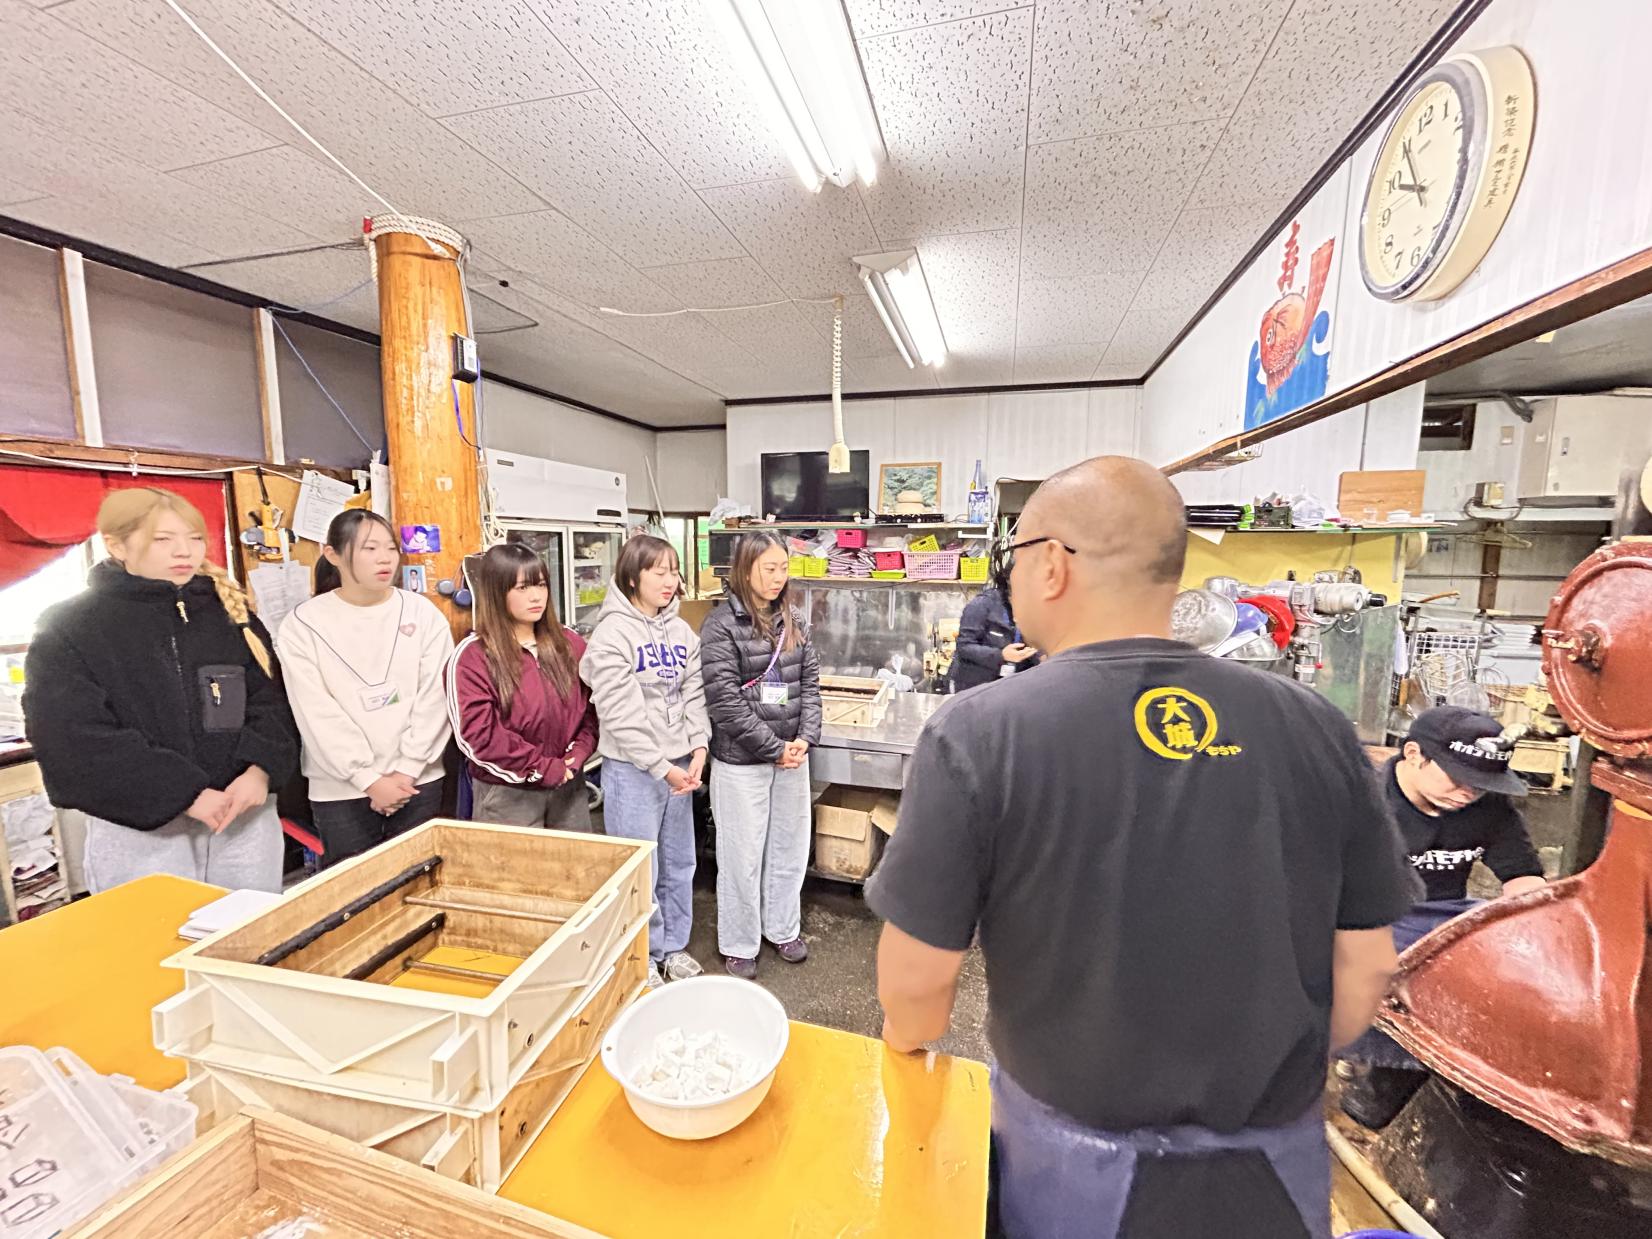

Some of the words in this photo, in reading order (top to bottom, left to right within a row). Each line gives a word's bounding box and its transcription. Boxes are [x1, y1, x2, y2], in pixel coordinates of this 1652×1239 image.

[1417, 104, 1435, 136] 12
[1453, 110, 1463, 136] 2
[1387, 169, 1403, 196] 10
[1381, 207, 1392, 228] 9
[1383, 234, 1394, 254] 8
[1394, 251, 1404, 271] 7
[1410, 245, 1422, 268] 6
